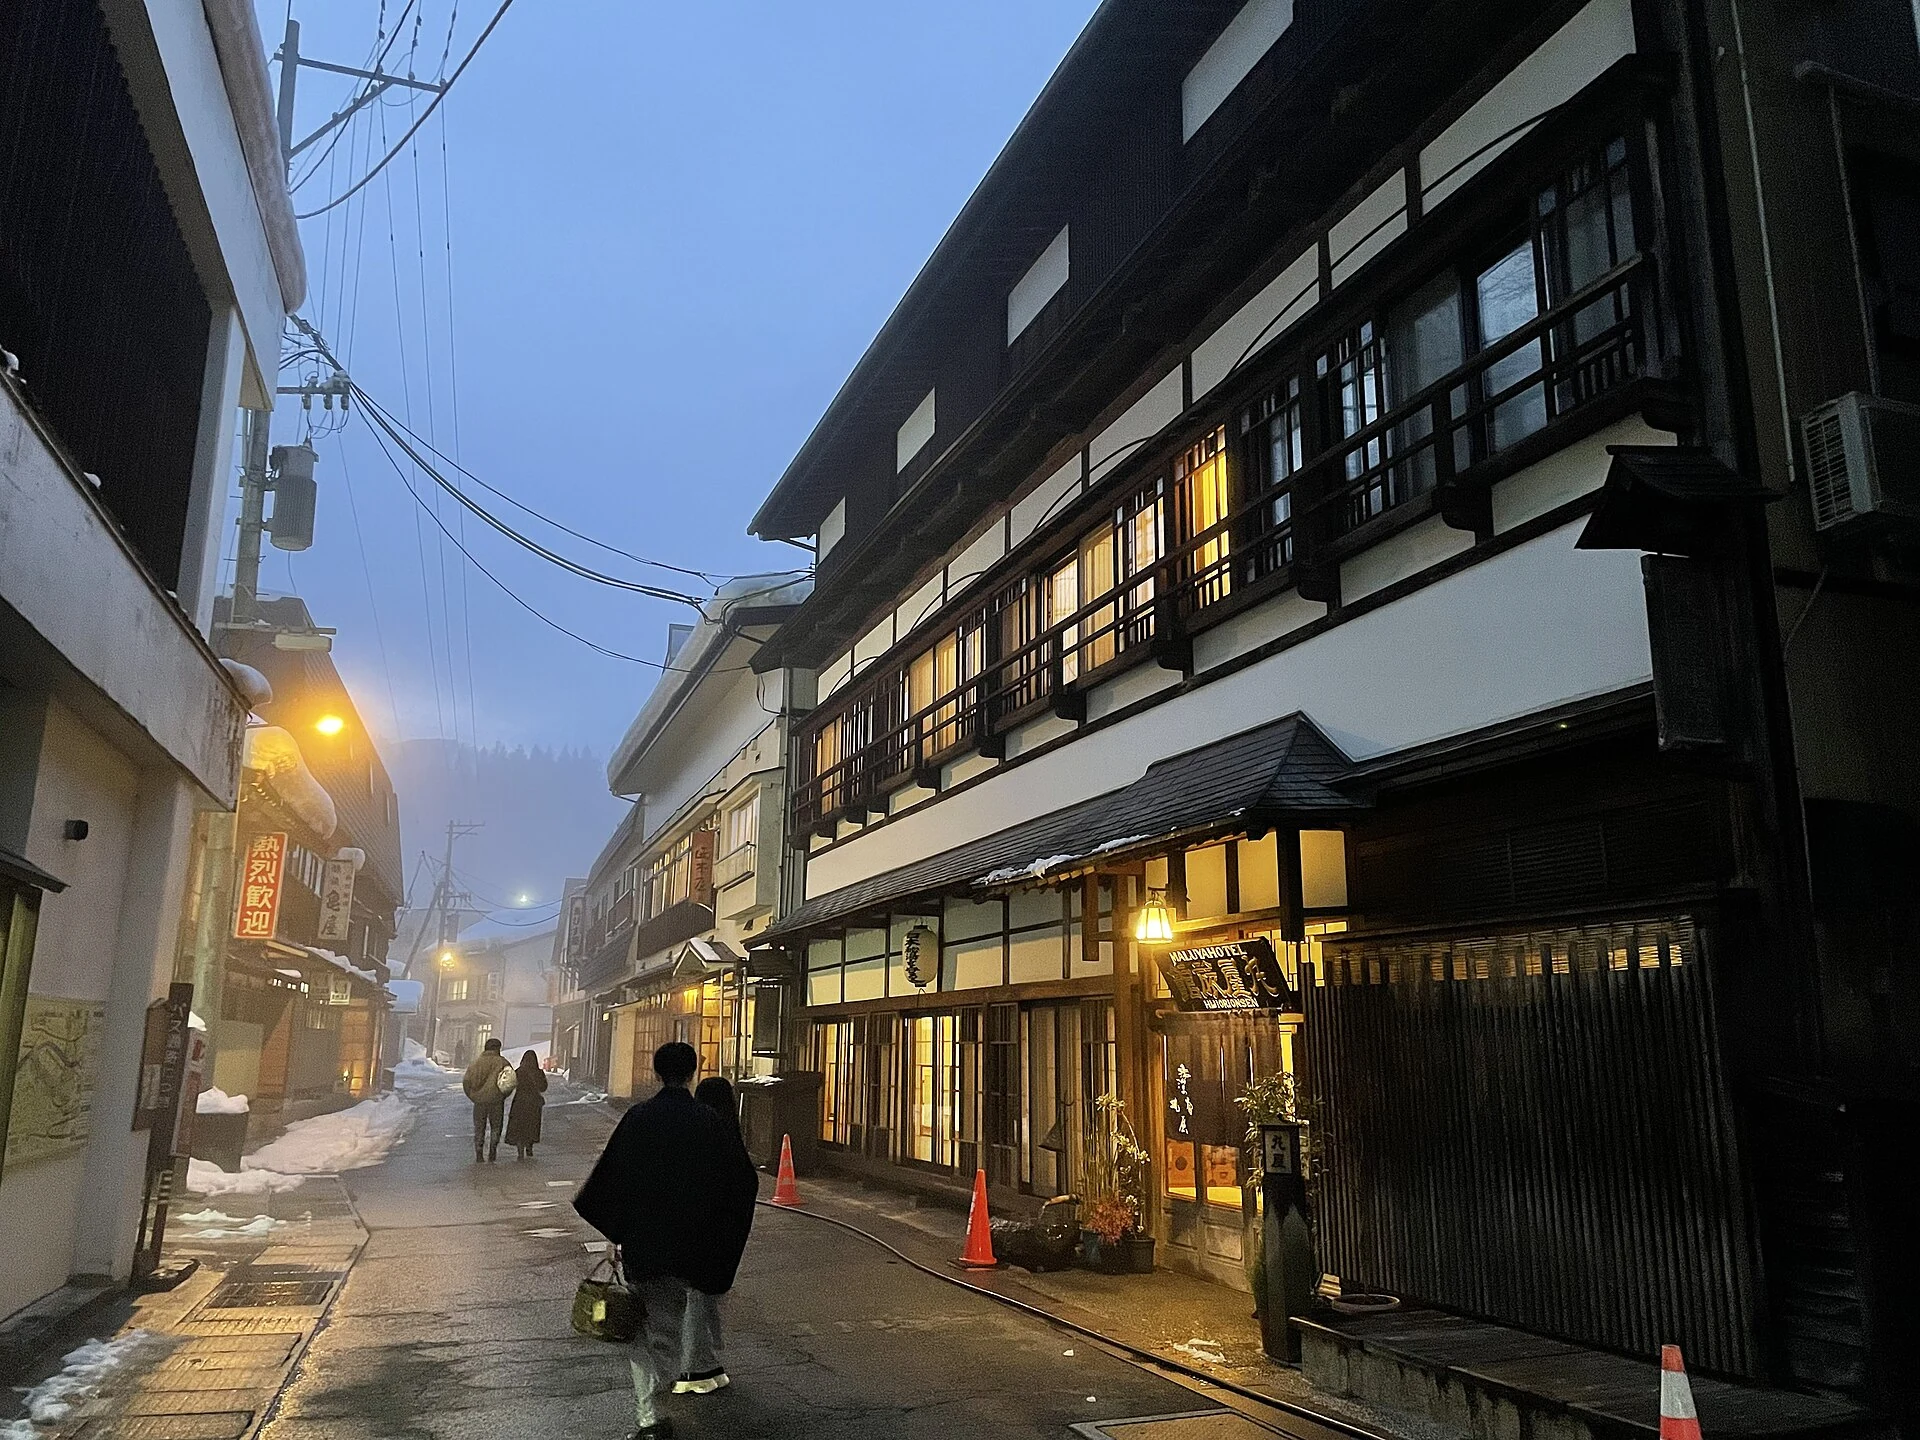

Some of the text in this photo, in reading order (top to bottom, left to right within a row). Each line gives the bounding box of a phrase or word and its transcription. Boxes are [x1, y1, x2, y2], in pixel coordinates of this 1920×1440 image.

[242, 835, 280, 935] 熱烈歓迎
[1271, 1134, 1286, 1168] 丸屋
